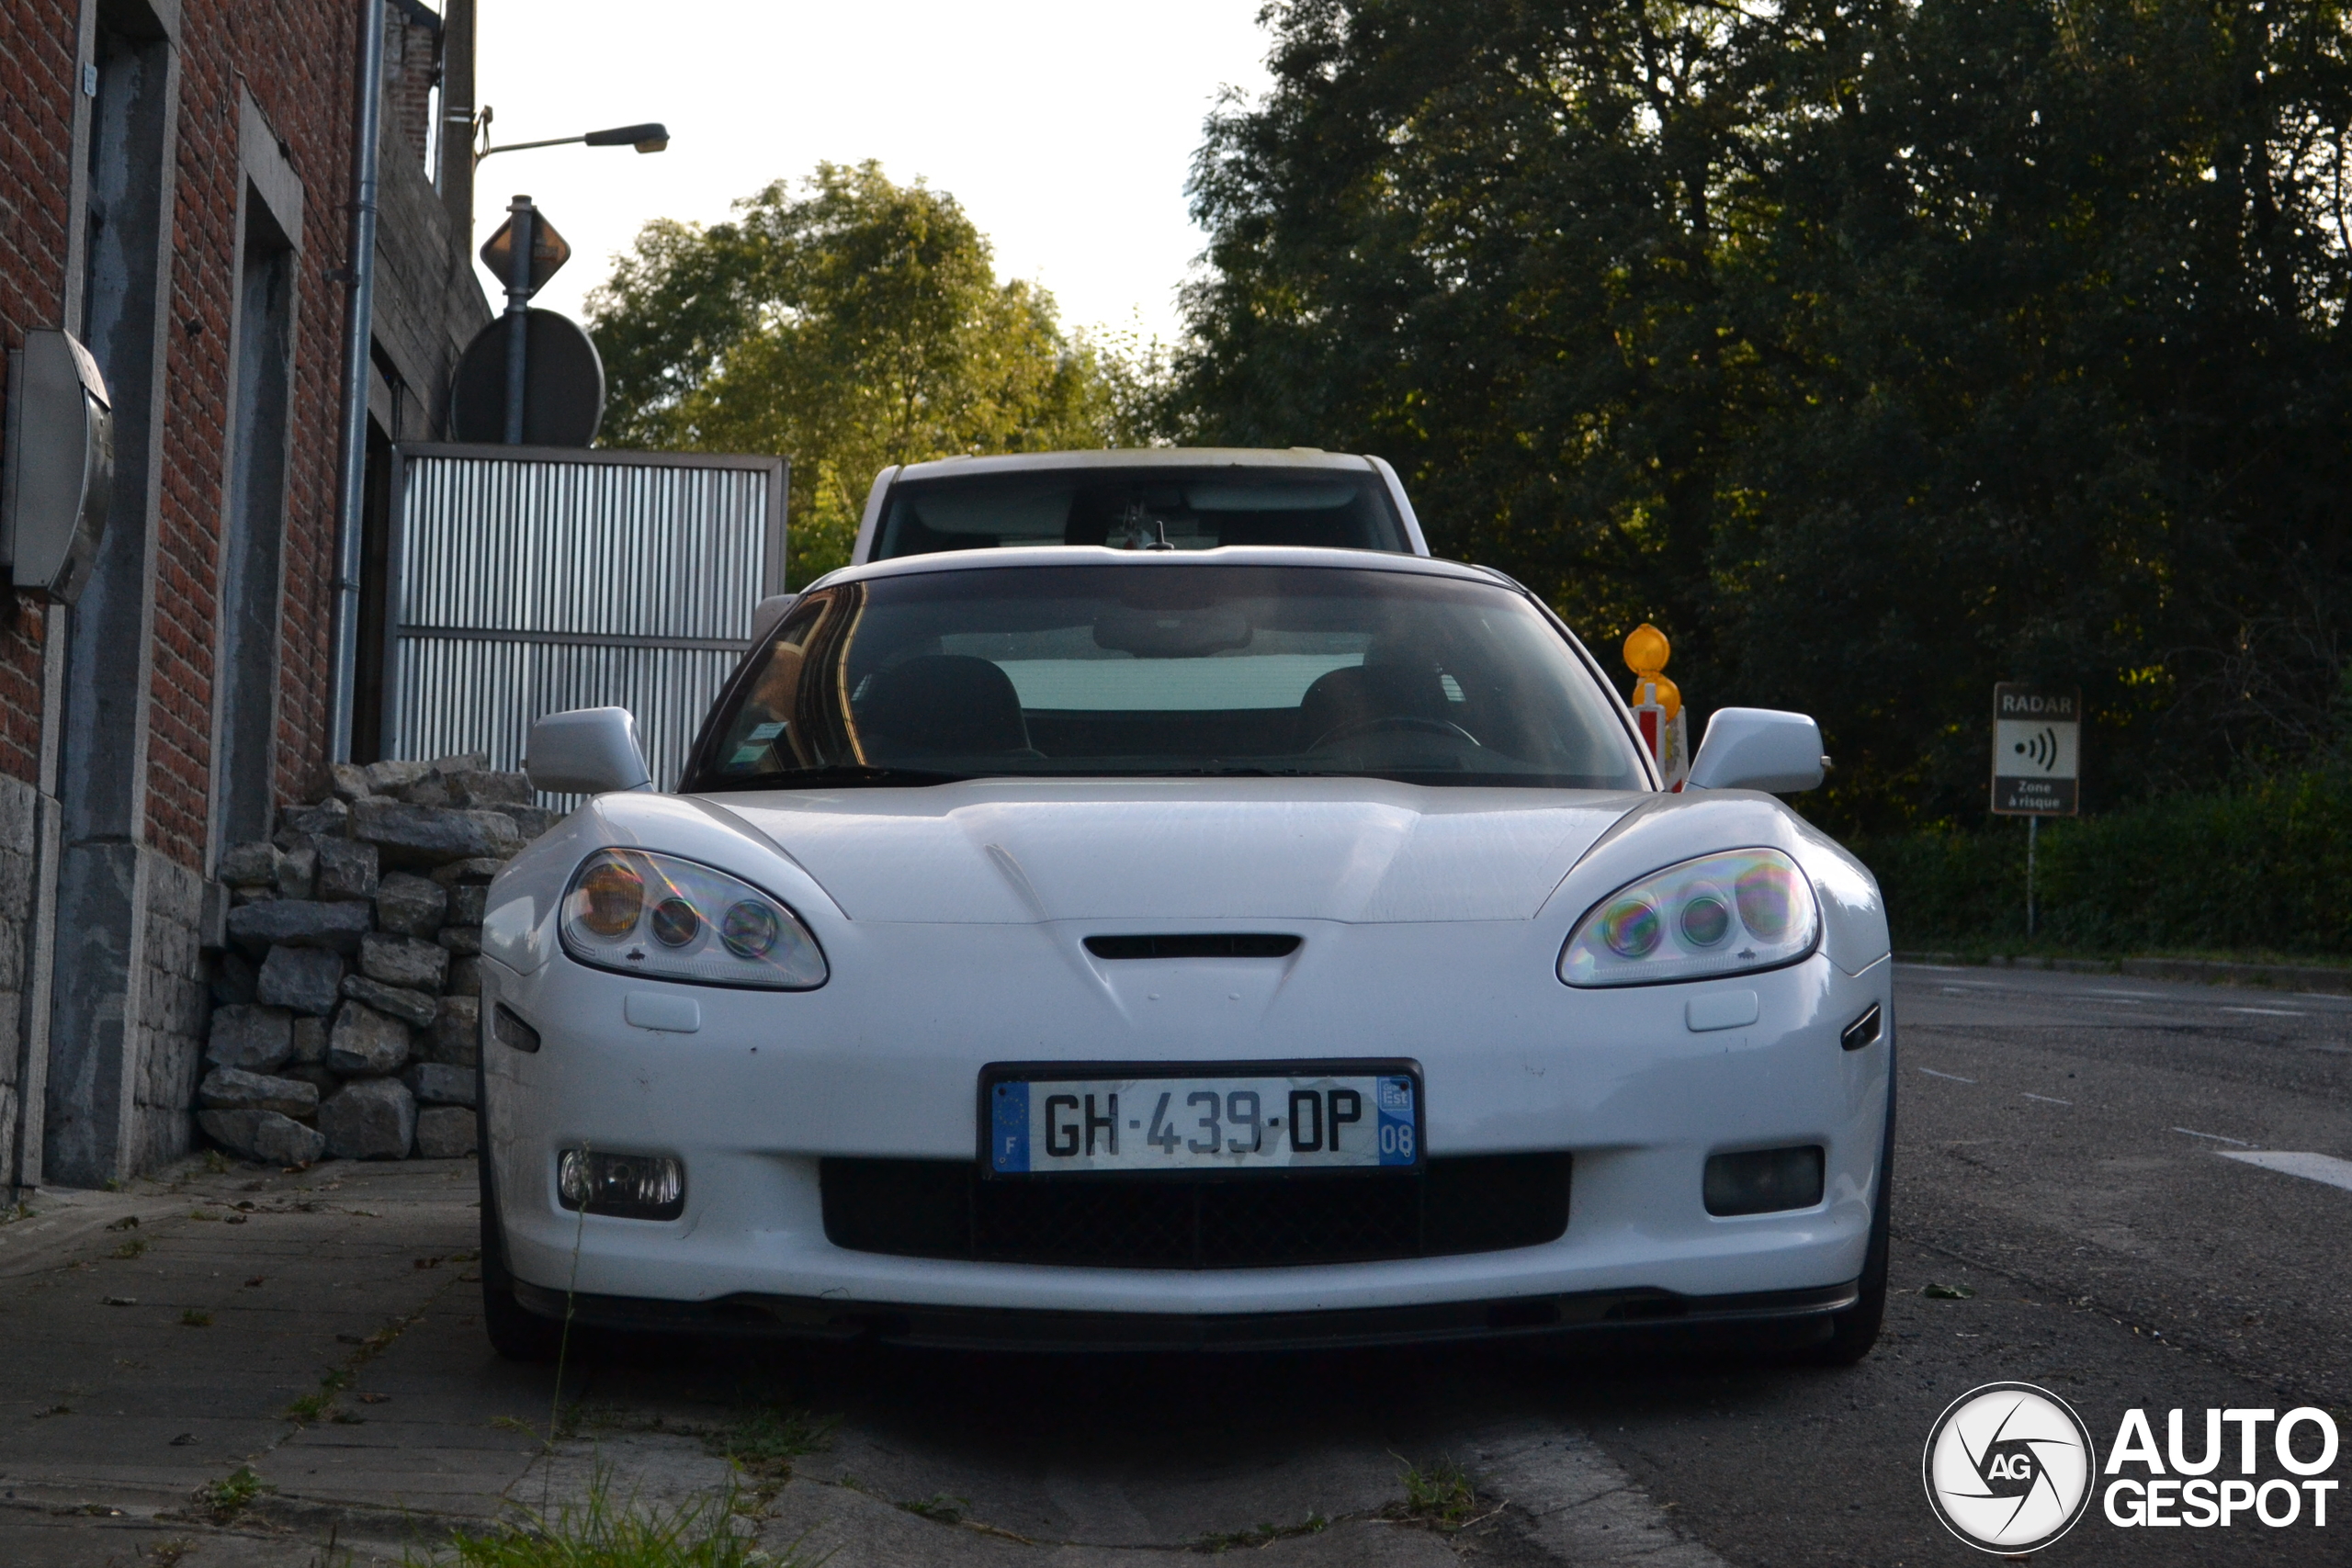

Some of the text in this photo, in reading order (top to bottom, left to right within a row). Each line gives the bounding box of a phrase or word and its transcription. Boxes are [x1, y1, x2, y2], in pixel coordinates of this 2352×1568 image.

[2003, 695, 2071, 713] RADAR
[2018, 781, 2051, 792] Zone
[2008, 795, 2060, 810] à risque
[1383, 1090, 1408, 1104] Est
[1046, 1089, 1362, 1156] GH-439-DP
[1005, 1136, 1015, 1154] F
[1381, 1124, 1413, 1155] 08
